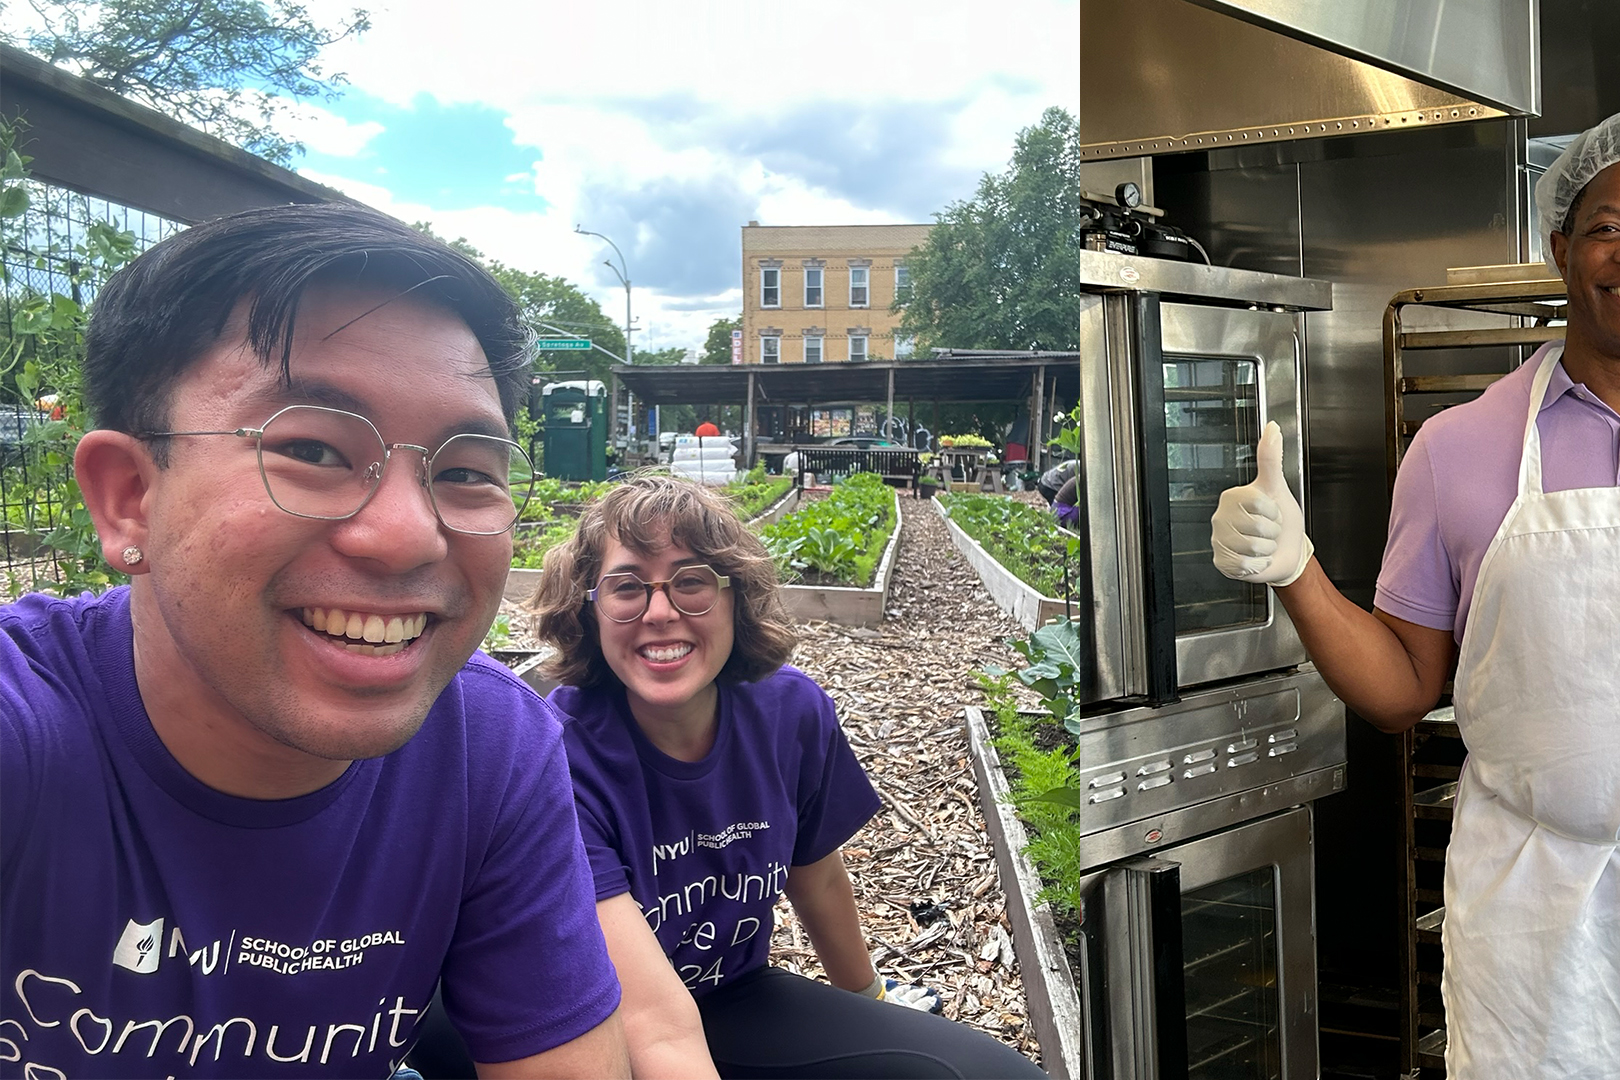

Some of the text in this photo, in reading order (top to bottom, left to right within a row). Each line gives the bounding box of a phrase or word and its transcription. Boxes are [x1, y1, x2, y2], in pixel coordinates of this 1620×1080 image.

[725, 823, 736, 835] OF
[736, 821, 770, 831] GLOBAL
[652, 836, 689, 876] NYU
[240, 931, 405, 961] SCHOOL OF GLOBAL
[237, 951, 364, 975] PUBLIC HEALTH
